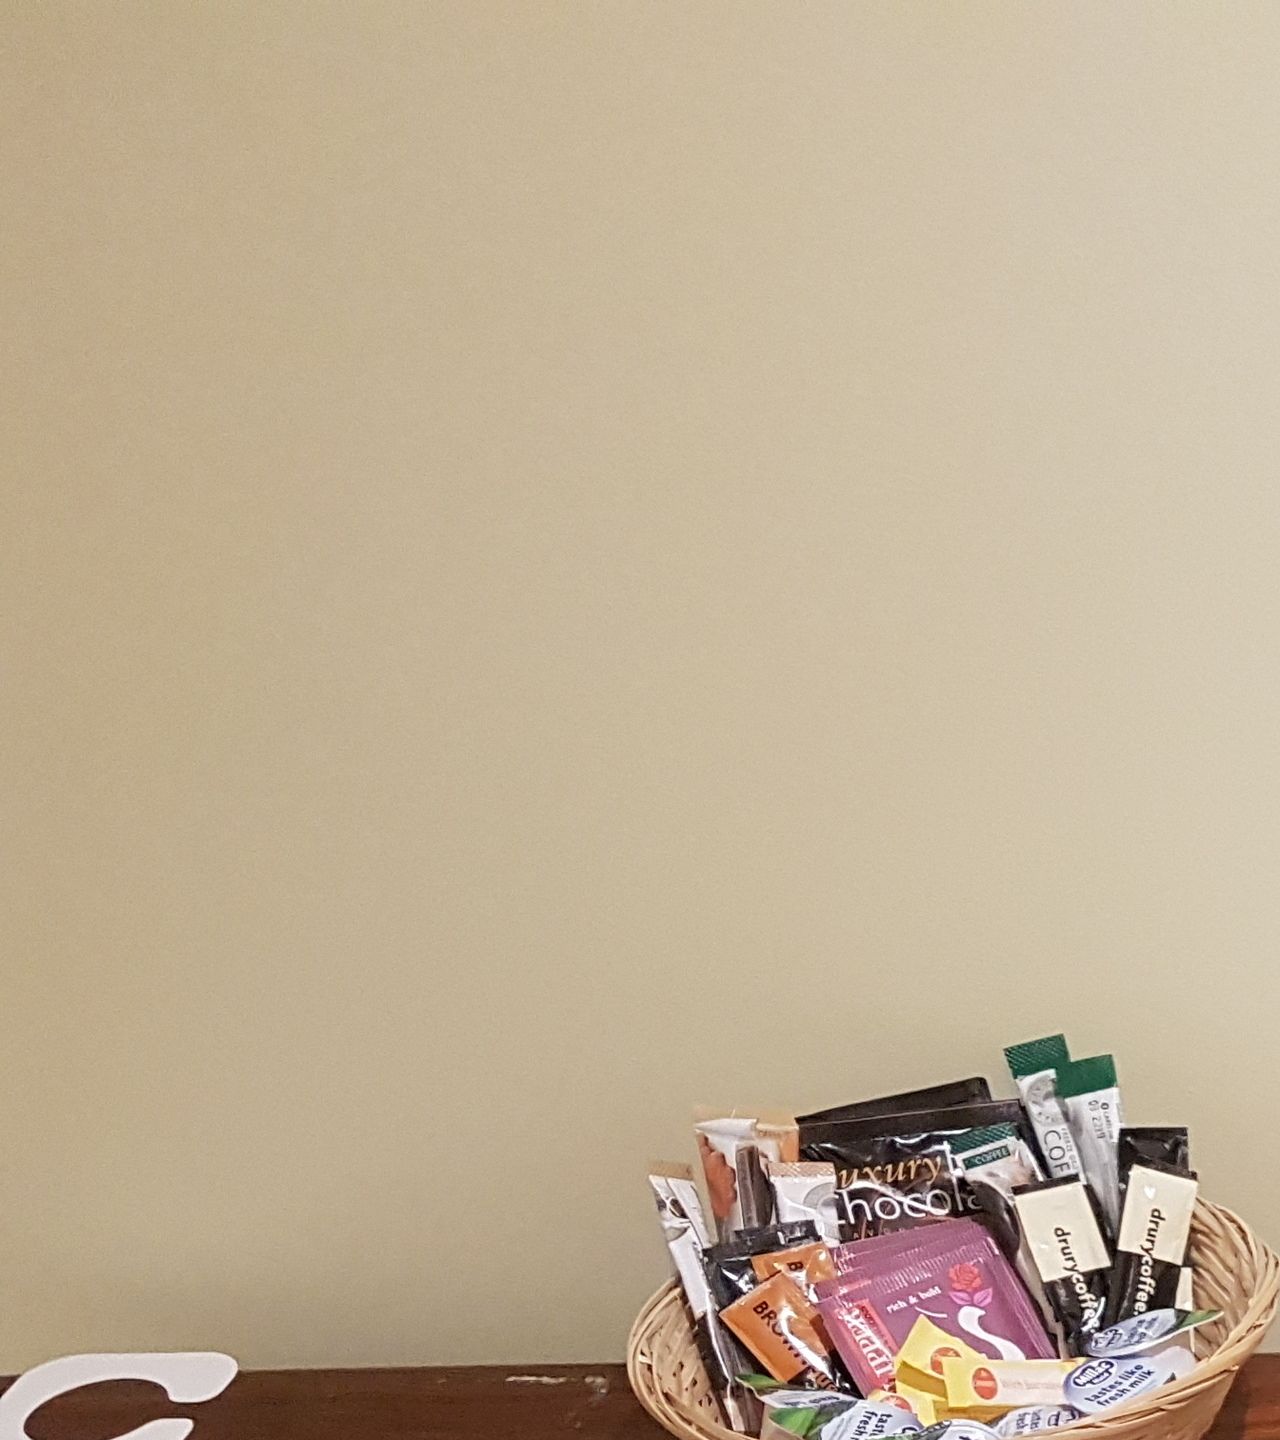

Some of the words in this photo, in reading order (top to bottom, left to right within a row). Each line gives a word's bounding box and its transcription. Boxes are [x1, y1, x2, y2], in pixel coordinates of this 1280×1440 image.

[838, 1155, 942, 1189] uxury
[1043, 1129, 1071, 1177] COF
[1084, 1379, 1123, 1403] tastes
[1119, 1364, 1145, 1382] like
[1096, 1387, 1132, 1407] fresh
[1129, 1369, 1156, 1391] milk
